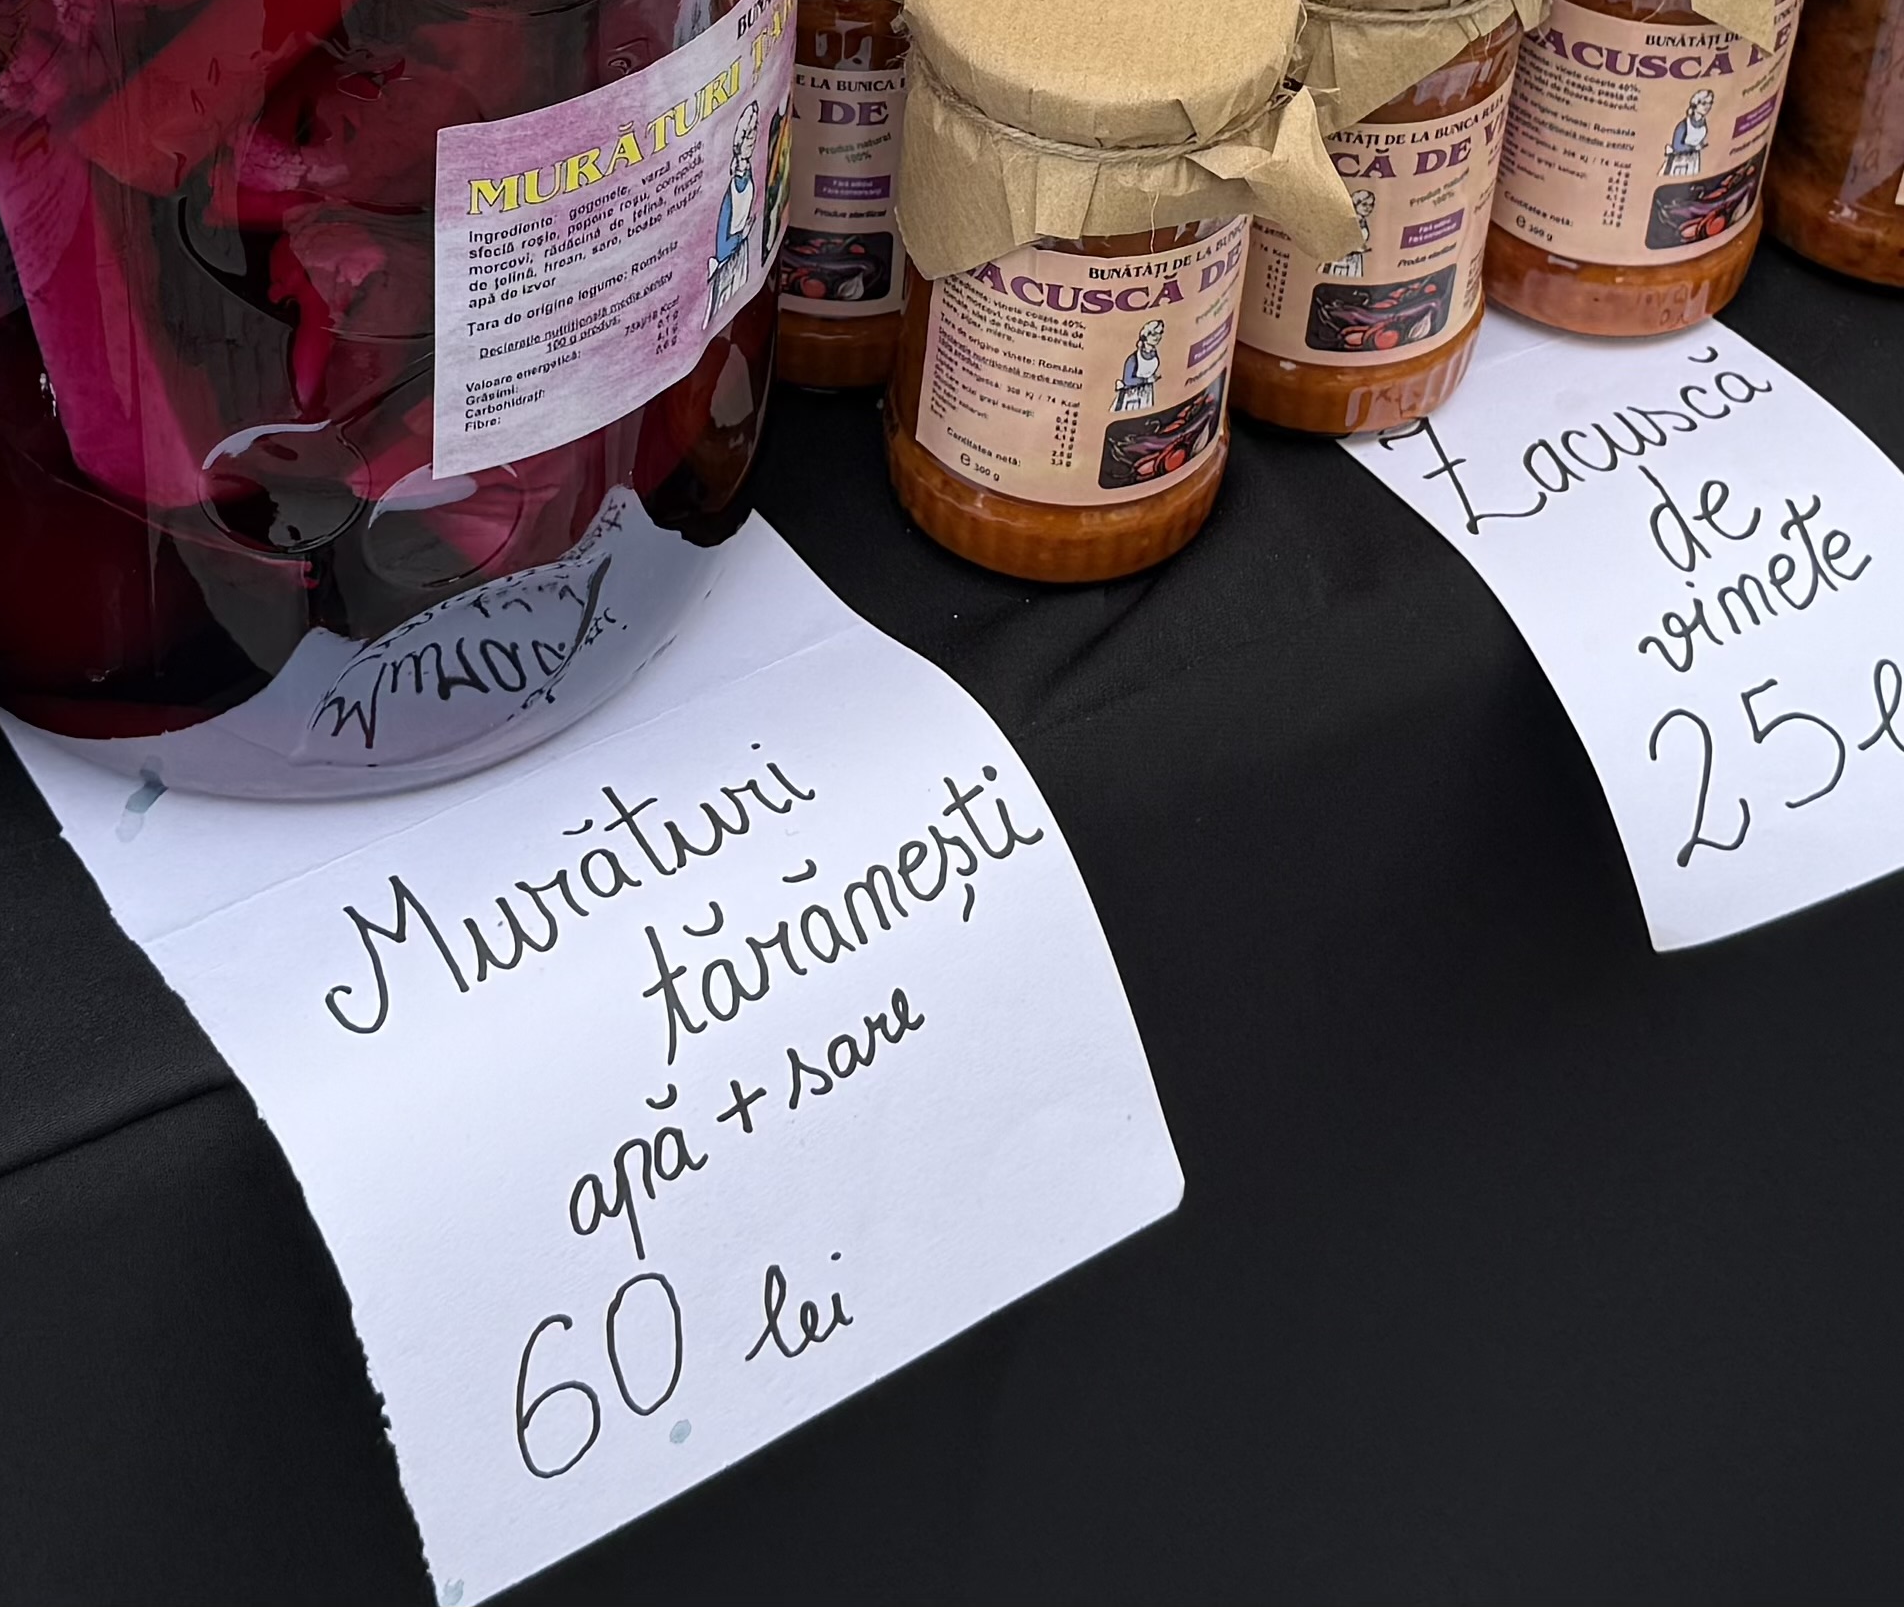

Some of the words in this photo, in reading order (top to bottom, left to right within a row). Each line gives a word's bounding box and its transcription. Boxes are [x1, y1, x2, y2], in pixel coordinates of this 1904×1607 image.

[811, 77, 830, 91] LA
[837, 80, 894, 92] BUNICA
[818, 99, 889, 126] DE
[467, 57, 742, 215] MURĂTURI
[1385, 134, 1405, 145] DE
[1411, 130, 1431, 143] LA
[1413, 137, 1471, 176] DE
[469, 243, 515, 259] sfeclă
[469, 253, 534, 276] morcovi,
[1089, 261, 1167, 280] BUNĂTĂȚI
[1173, 255, 1191, 271] DE
[1199, 239, 1241, 292] DE
[469, 291, 496, 310] apă
[527, 295, 573, 319] origine
[466, 373, 512, 392] Valoare
[1378, 345, 1773, 536] Zacuscă
[1637, 464, 1761, 572] de
[1649, 678, 1846, 868] 25
[326, 740, 815, 1036] Murături
[569, 1084, 709, 1260] apă
[715, 1080, 767, 1134] +
[785, 987, 926, 1111] sare
[514, 1272, 685, 1481] 60
[744, 1251, 855, 1362] lei
